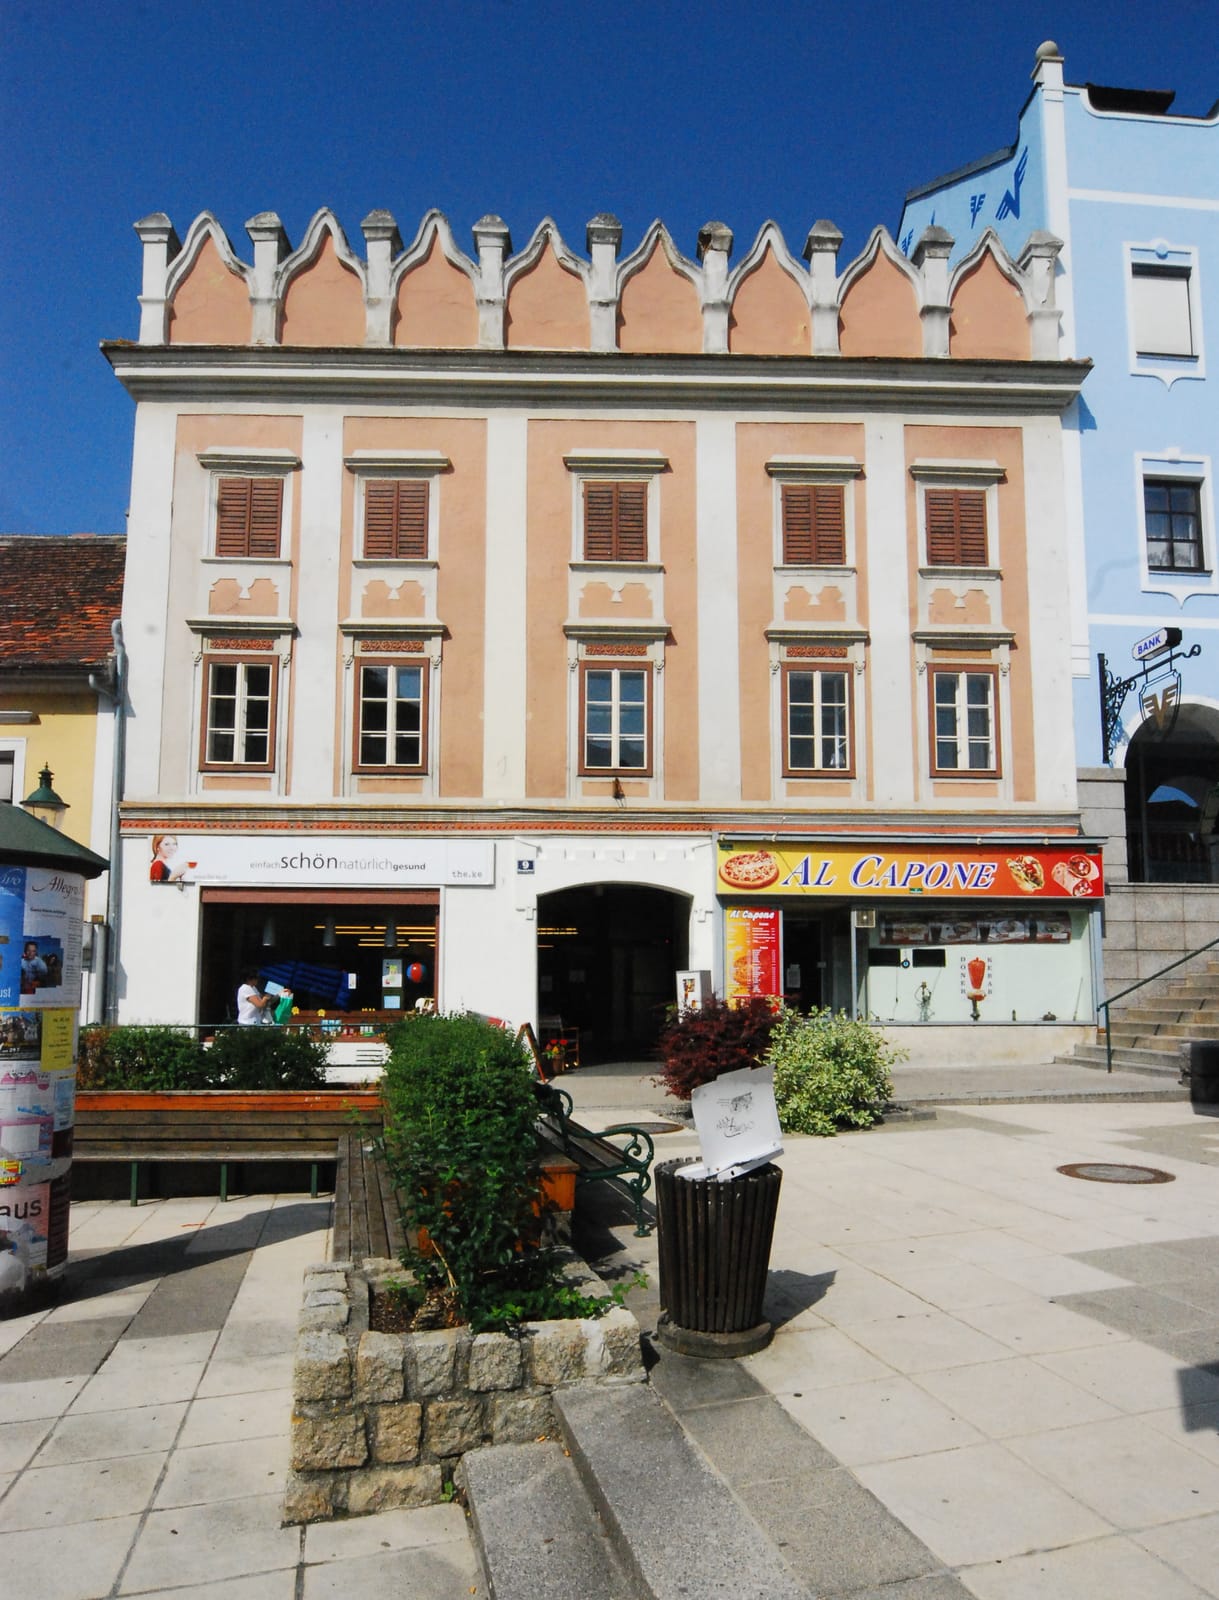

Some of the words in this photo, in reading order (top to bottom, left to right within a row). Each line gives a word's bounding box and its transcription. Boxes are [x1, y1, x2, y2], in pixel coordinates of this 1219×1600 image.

[1137, 634, 1161, 654] BANK
[280, 852, 338, 869] schön
[339, 858, 392, 870] natürlich
[392, 863, 426, 872] gesund
[522, 860, 530, 870] 9
[780, 854, 835, 887] AL
[850, 854, 998, 890] CAPONE
[451, 869, 483, 878] the.ke
